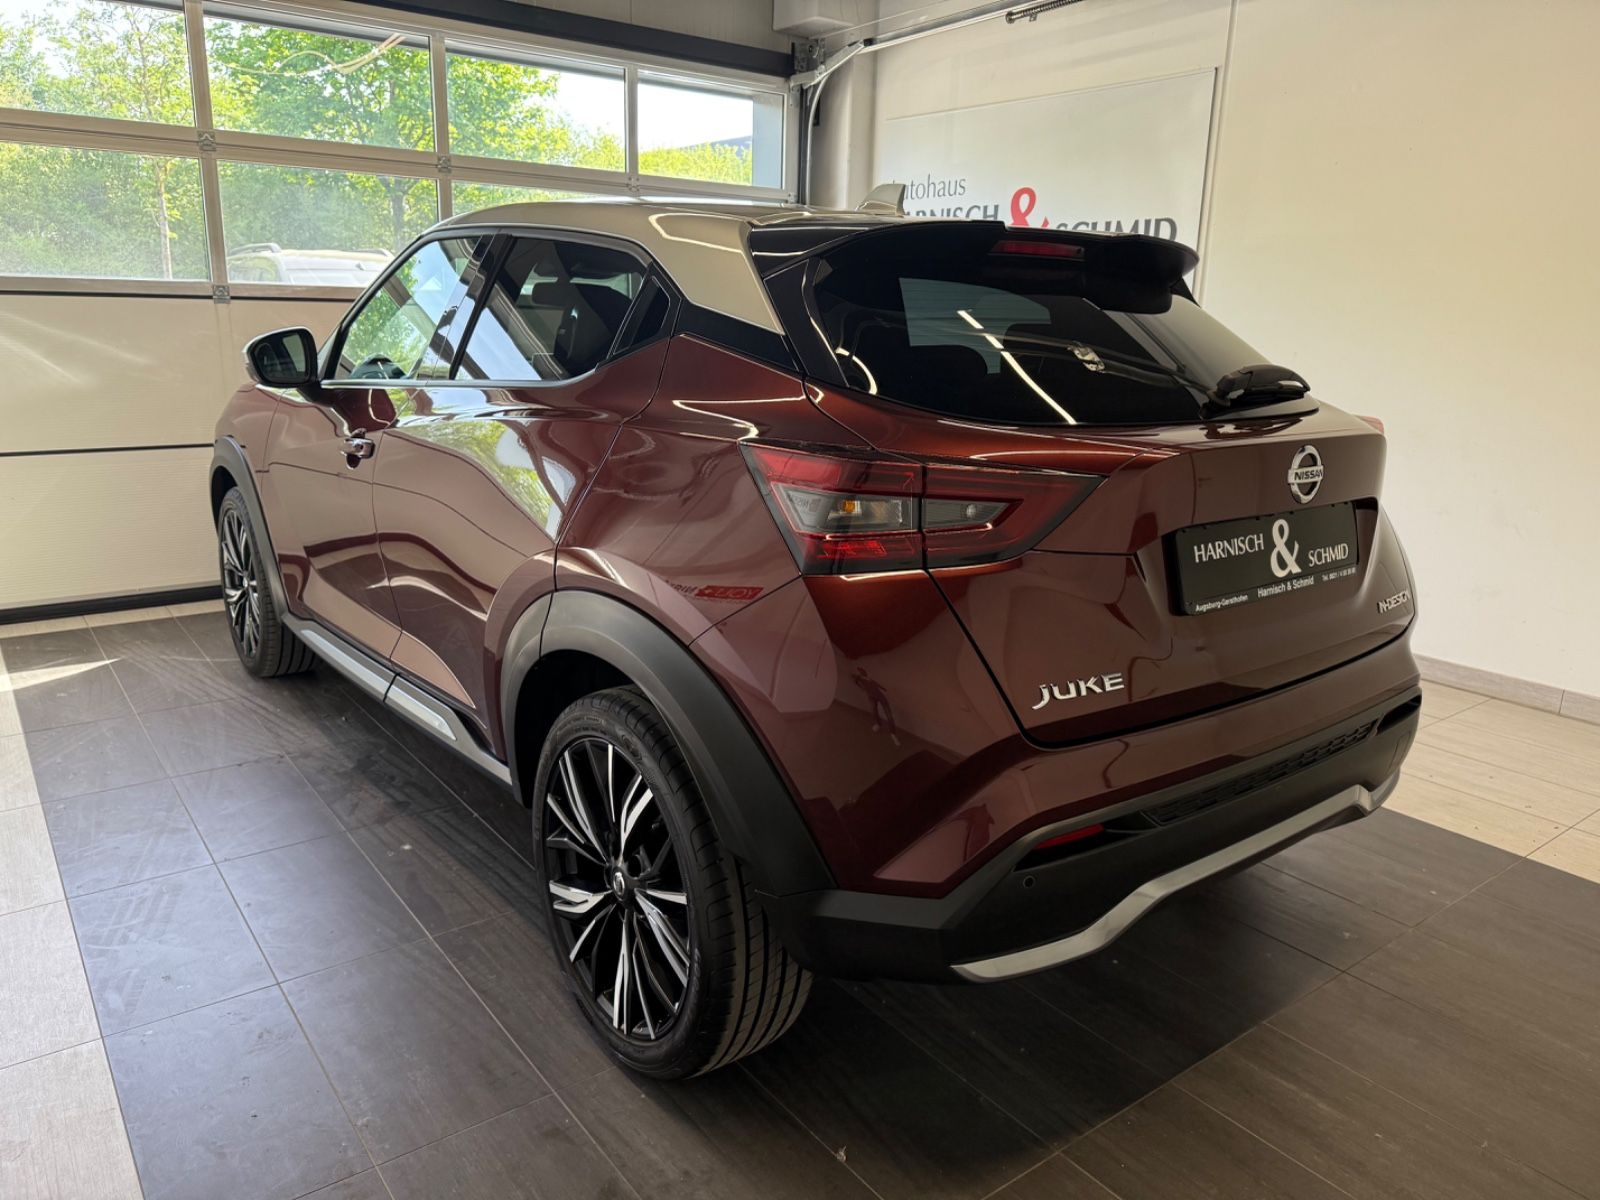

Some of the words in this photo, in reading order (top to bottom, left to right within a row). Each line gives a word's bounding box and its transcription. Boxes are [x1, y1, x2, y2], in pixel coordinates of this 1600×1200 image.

[893, 173, 966, 200] tohaus
[1294, 469, 1323, 481] NISSAN
[1193, 533, 1265, 563] HARNISCH
[1270, 518, 1302, 578] &
[1308, 543, 1349, 567] SCHMID
[1257, 582, 1286, 598] Harnisch
[1286, 582, 1292, 591] &
[1292, 576, 1314, 590] Schmid
[1032, 672, 1125, 710] JUKE
